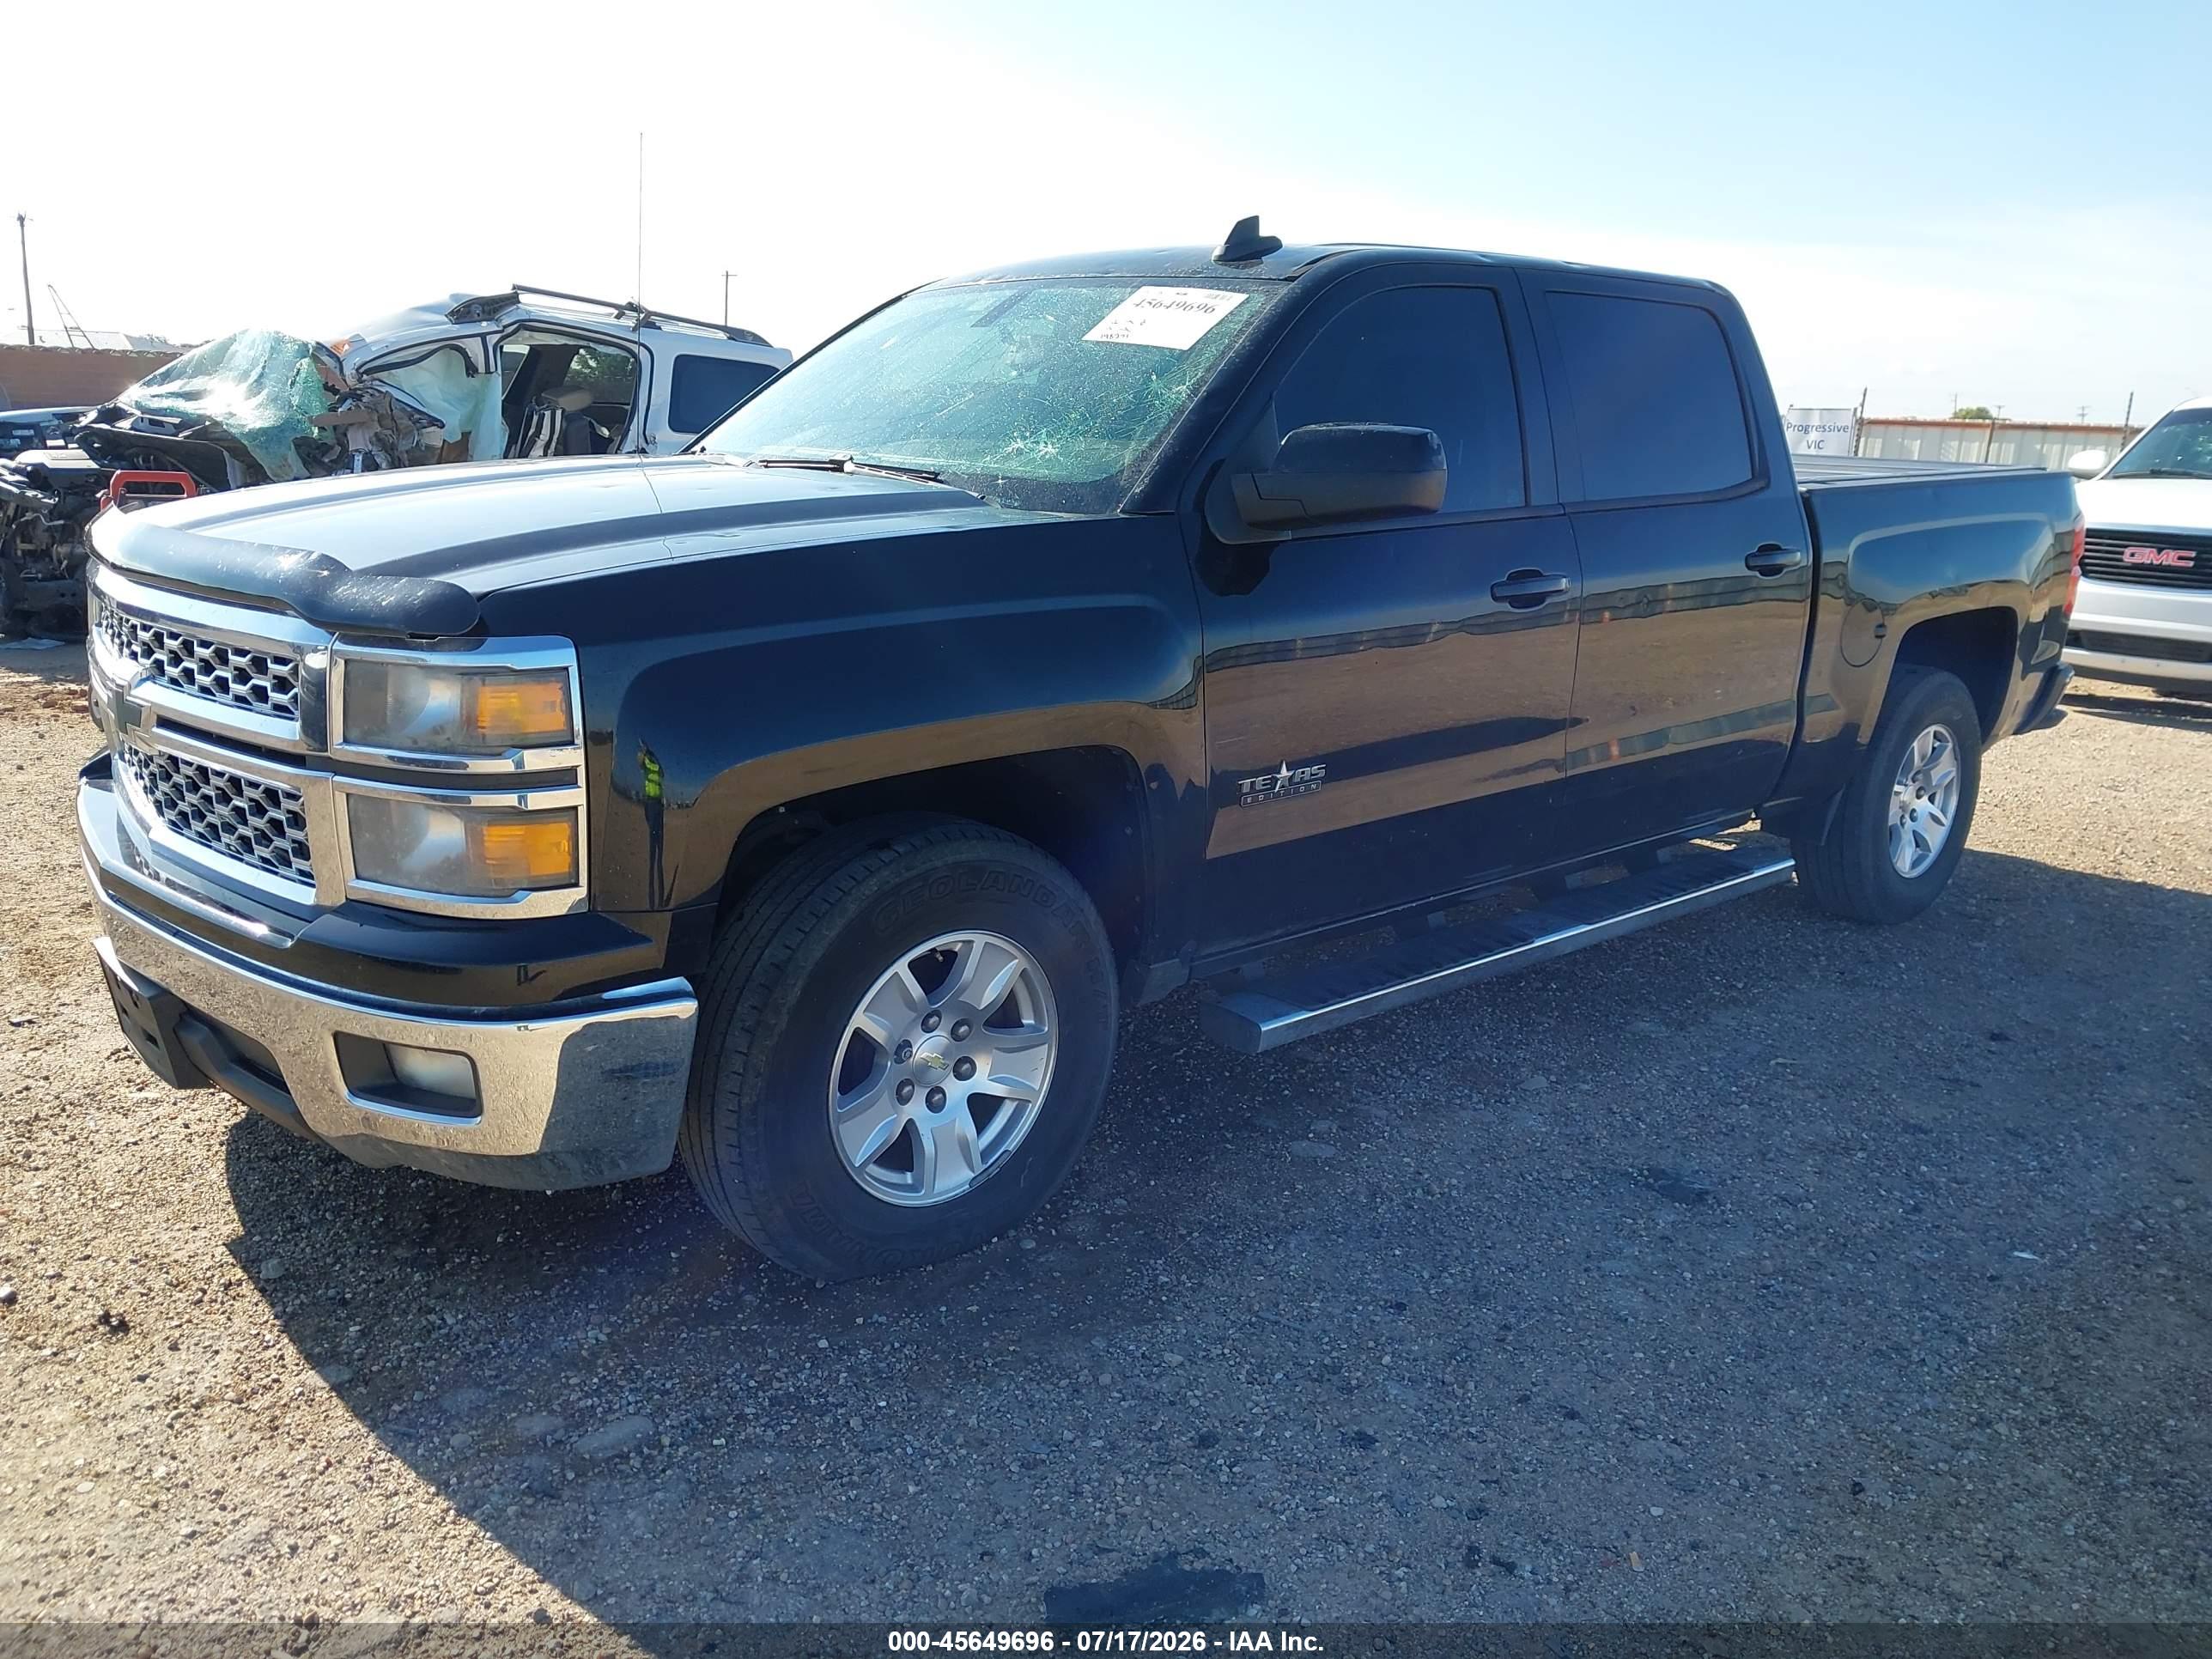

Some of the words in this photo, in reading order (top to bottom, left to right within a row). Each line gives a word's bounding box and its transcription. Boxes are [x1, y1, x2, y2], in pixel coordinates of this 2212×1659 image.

[1133, 298, 1218, 314] 45649696
[1786, 422, 1850, 434] Progressive
[1806, 439, 1826, 450] VIC
[2122, 546, 2197, 568] GMC
[1237, 759, 1327, 793] TEXAS
[1246, 782, 1318, 804] EDITION
